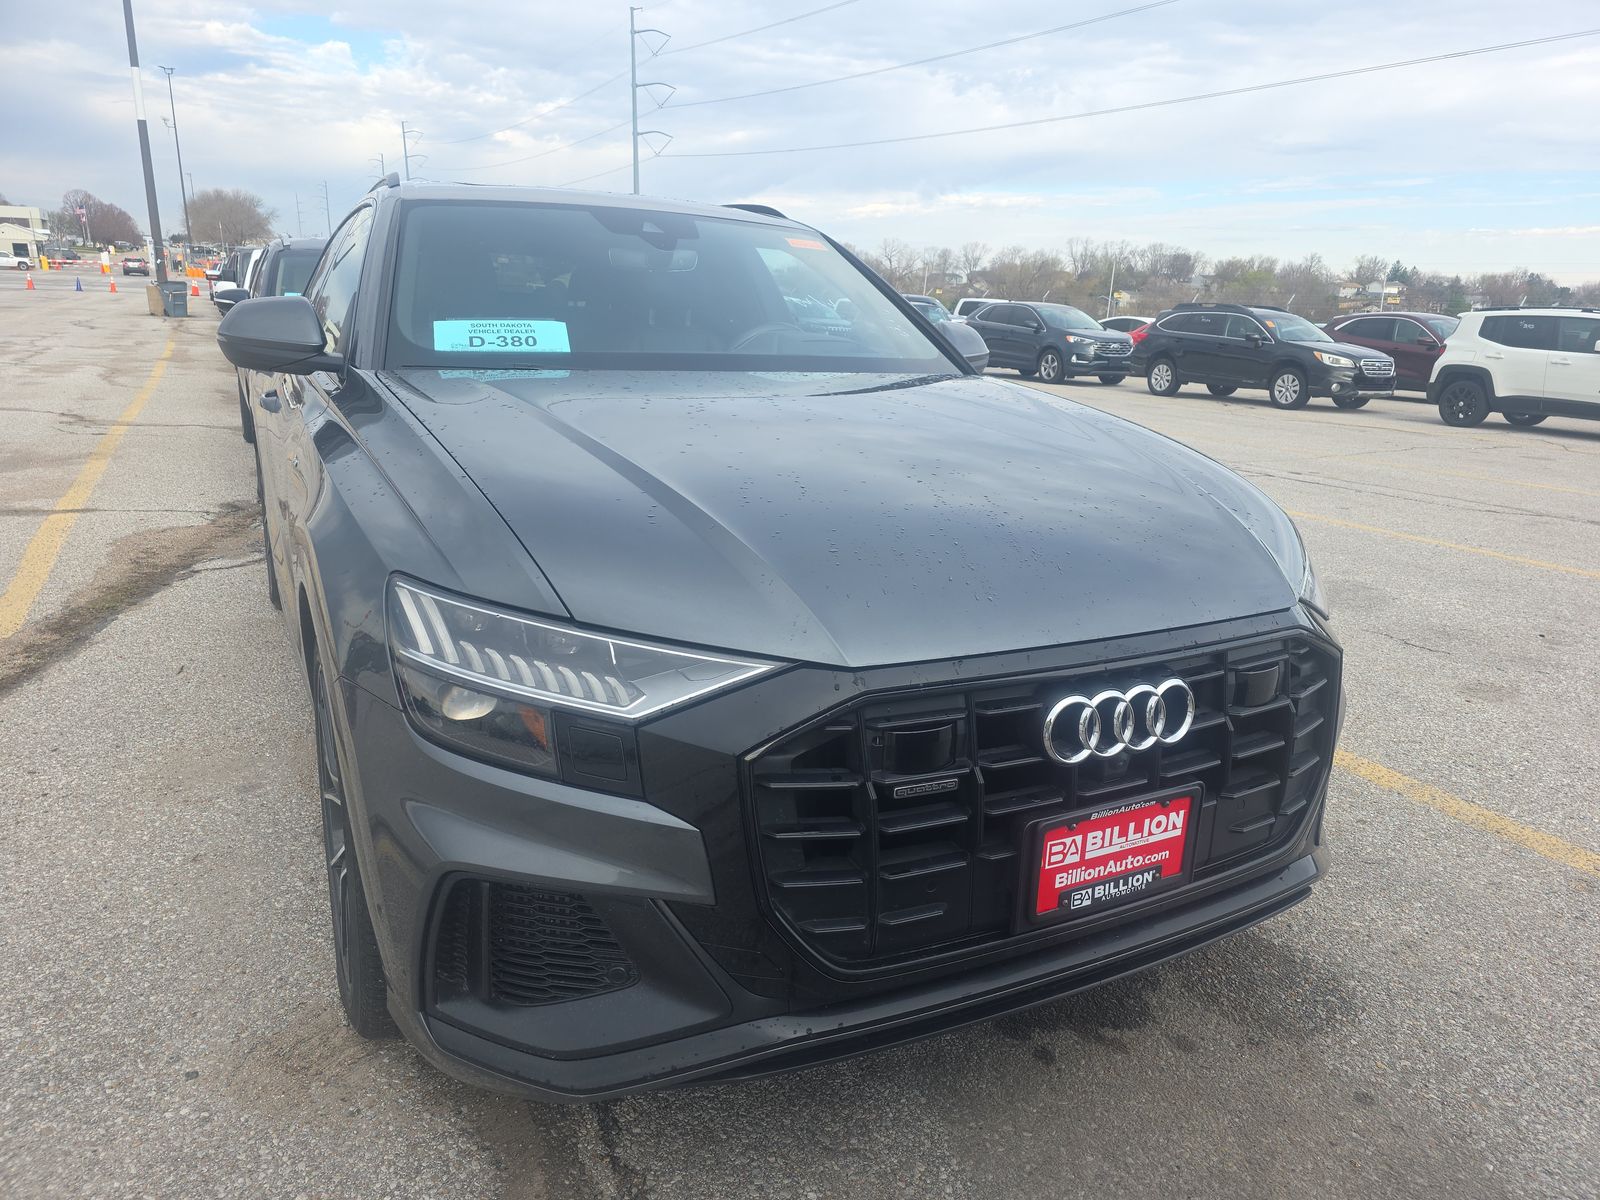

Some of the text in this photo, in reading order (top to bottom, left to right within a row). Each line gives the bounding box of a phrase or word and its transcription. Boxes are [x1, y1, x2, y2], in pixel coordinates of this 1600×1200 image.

[468, 336, 538, 348] D-380
[1090, 801, 1156, 821] BillionAuto.com
[1085, 810, 1185, 850] BILLION
[1119, 838, 1150, 849] AUTOMOTIVE
[1054, 850, 1170, 889] BillionAuto.com
[1094, 872, 1154, 899] BILLION
[1101, 883, 1146, 902] AUTOMOTIVE
